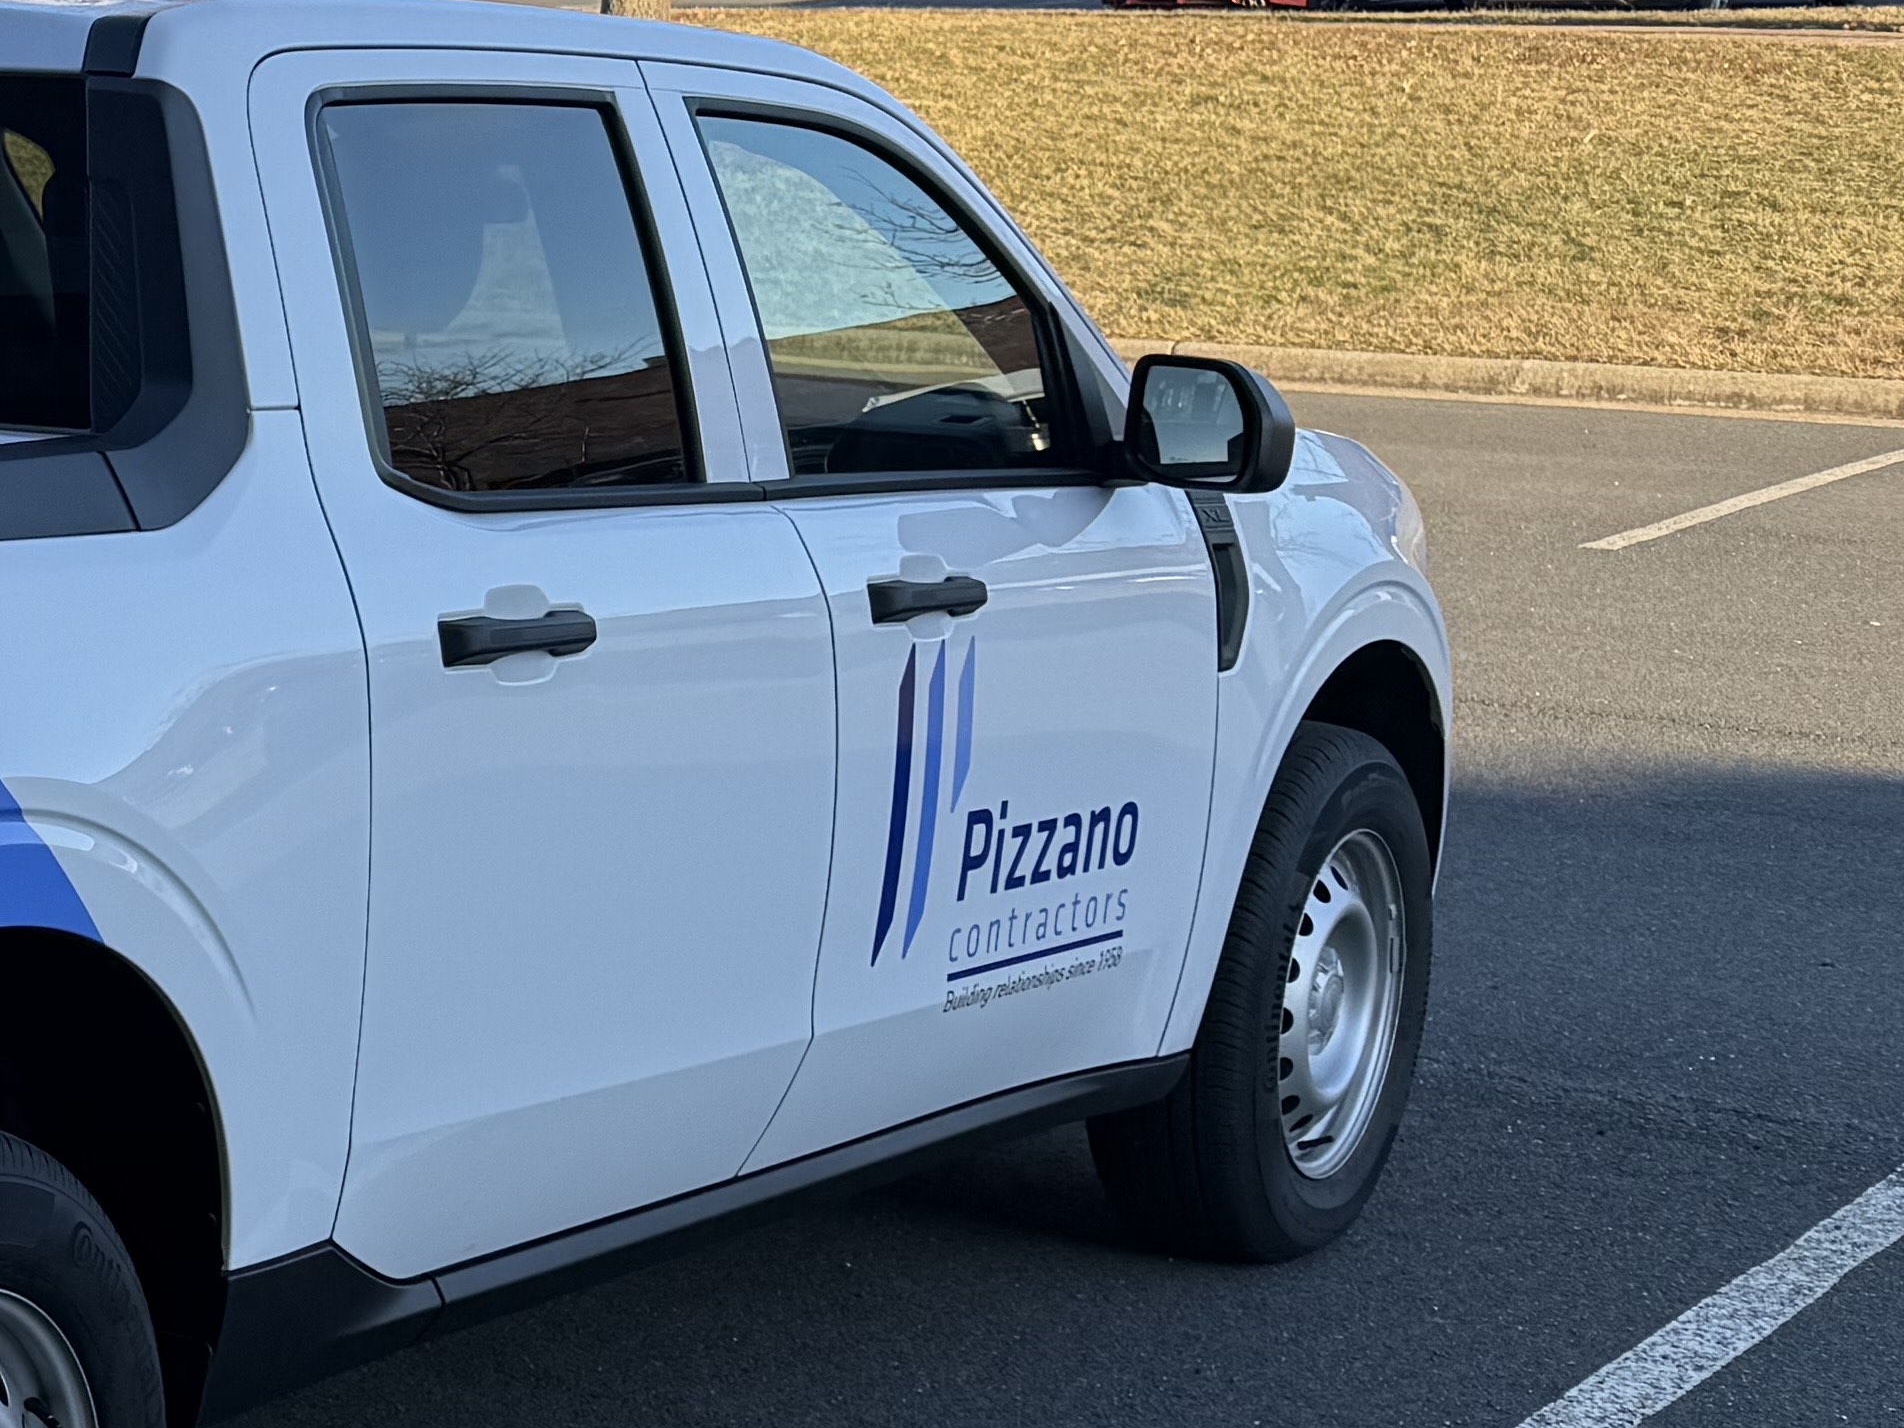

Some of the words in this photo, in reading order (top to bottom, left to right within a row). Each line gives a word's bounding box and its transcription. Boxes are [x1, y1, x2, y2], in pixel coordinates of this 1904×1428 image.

[956, 800, 1139, 902] Pizzano
[948, 887, 1129, 963] contractors
[943, 983, 993, 1013] Building
[992, 963, 1066, 1000] relationships
[1066, 957, 1097, 980] since
